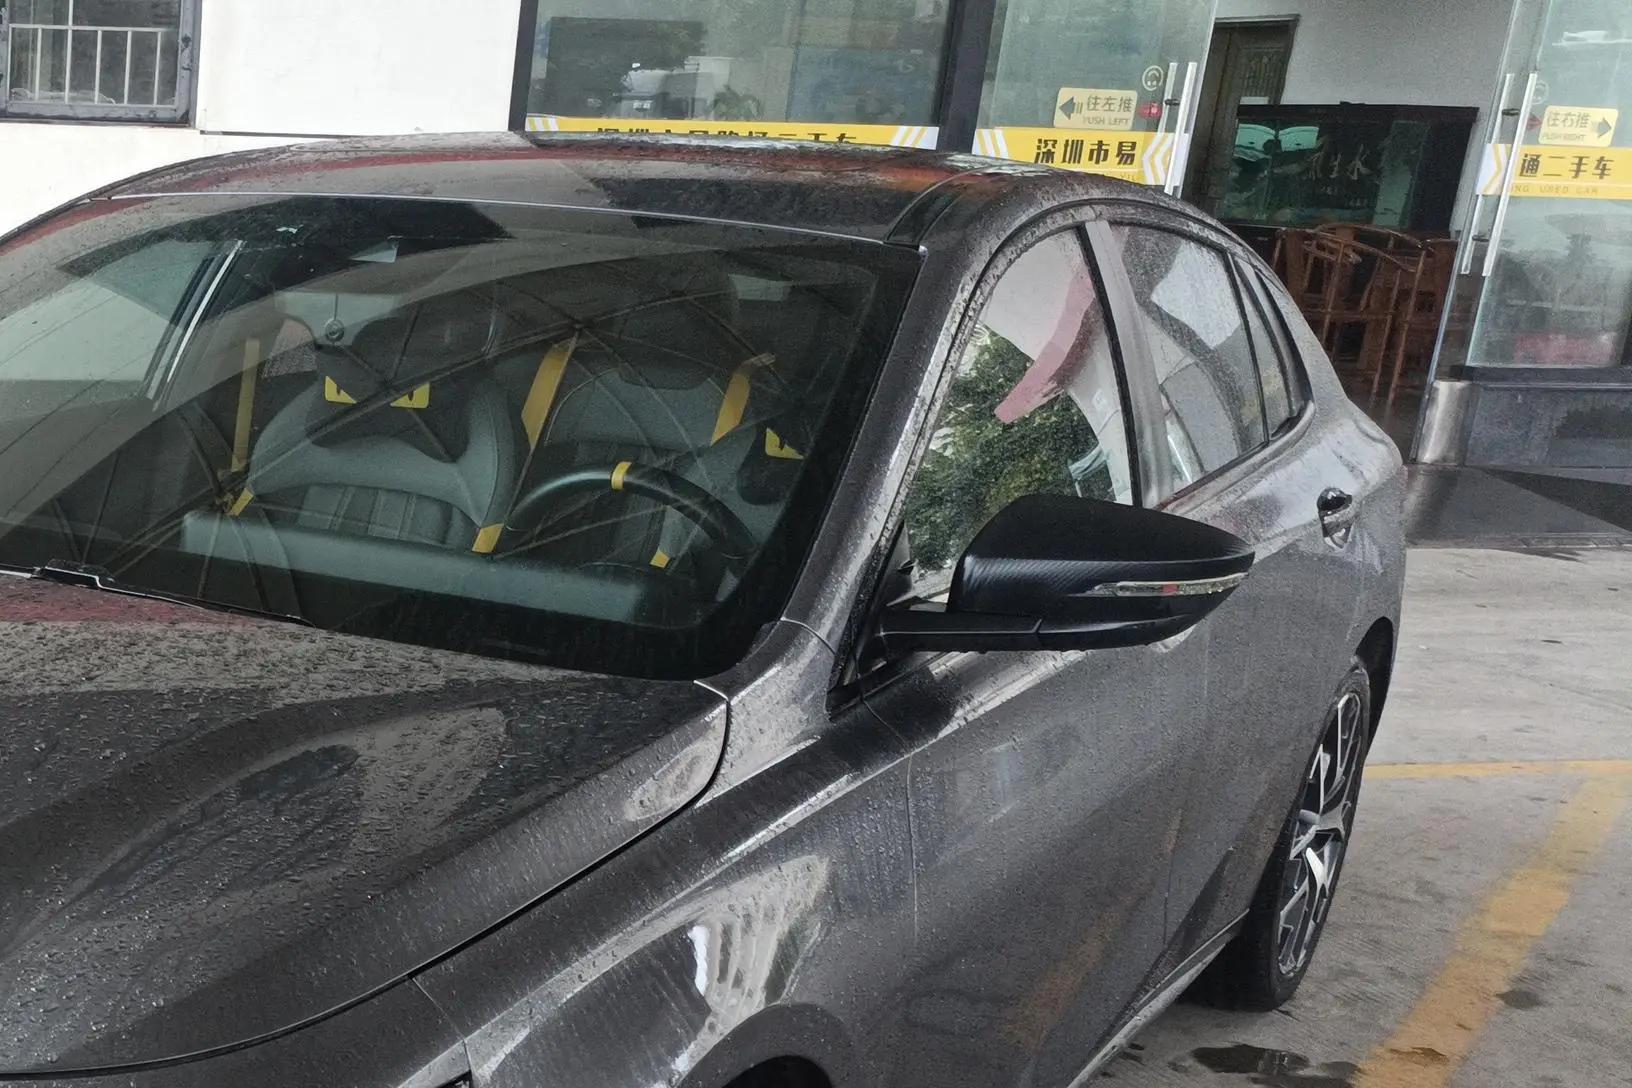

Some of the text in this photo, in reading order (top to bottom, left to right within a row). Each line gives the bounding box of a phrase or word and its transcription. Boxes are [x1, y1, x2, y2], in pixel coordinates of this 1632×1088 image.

[1086, 95, 1132, 112] 往左推
[1083, 116, 1131, 126] PUSH LEFT
[1547, 112, 1591, 128] 往右推
[1034, 138, 1138, 165] 深圳市易
[1519, 153, 1615, 180] 通二手车
